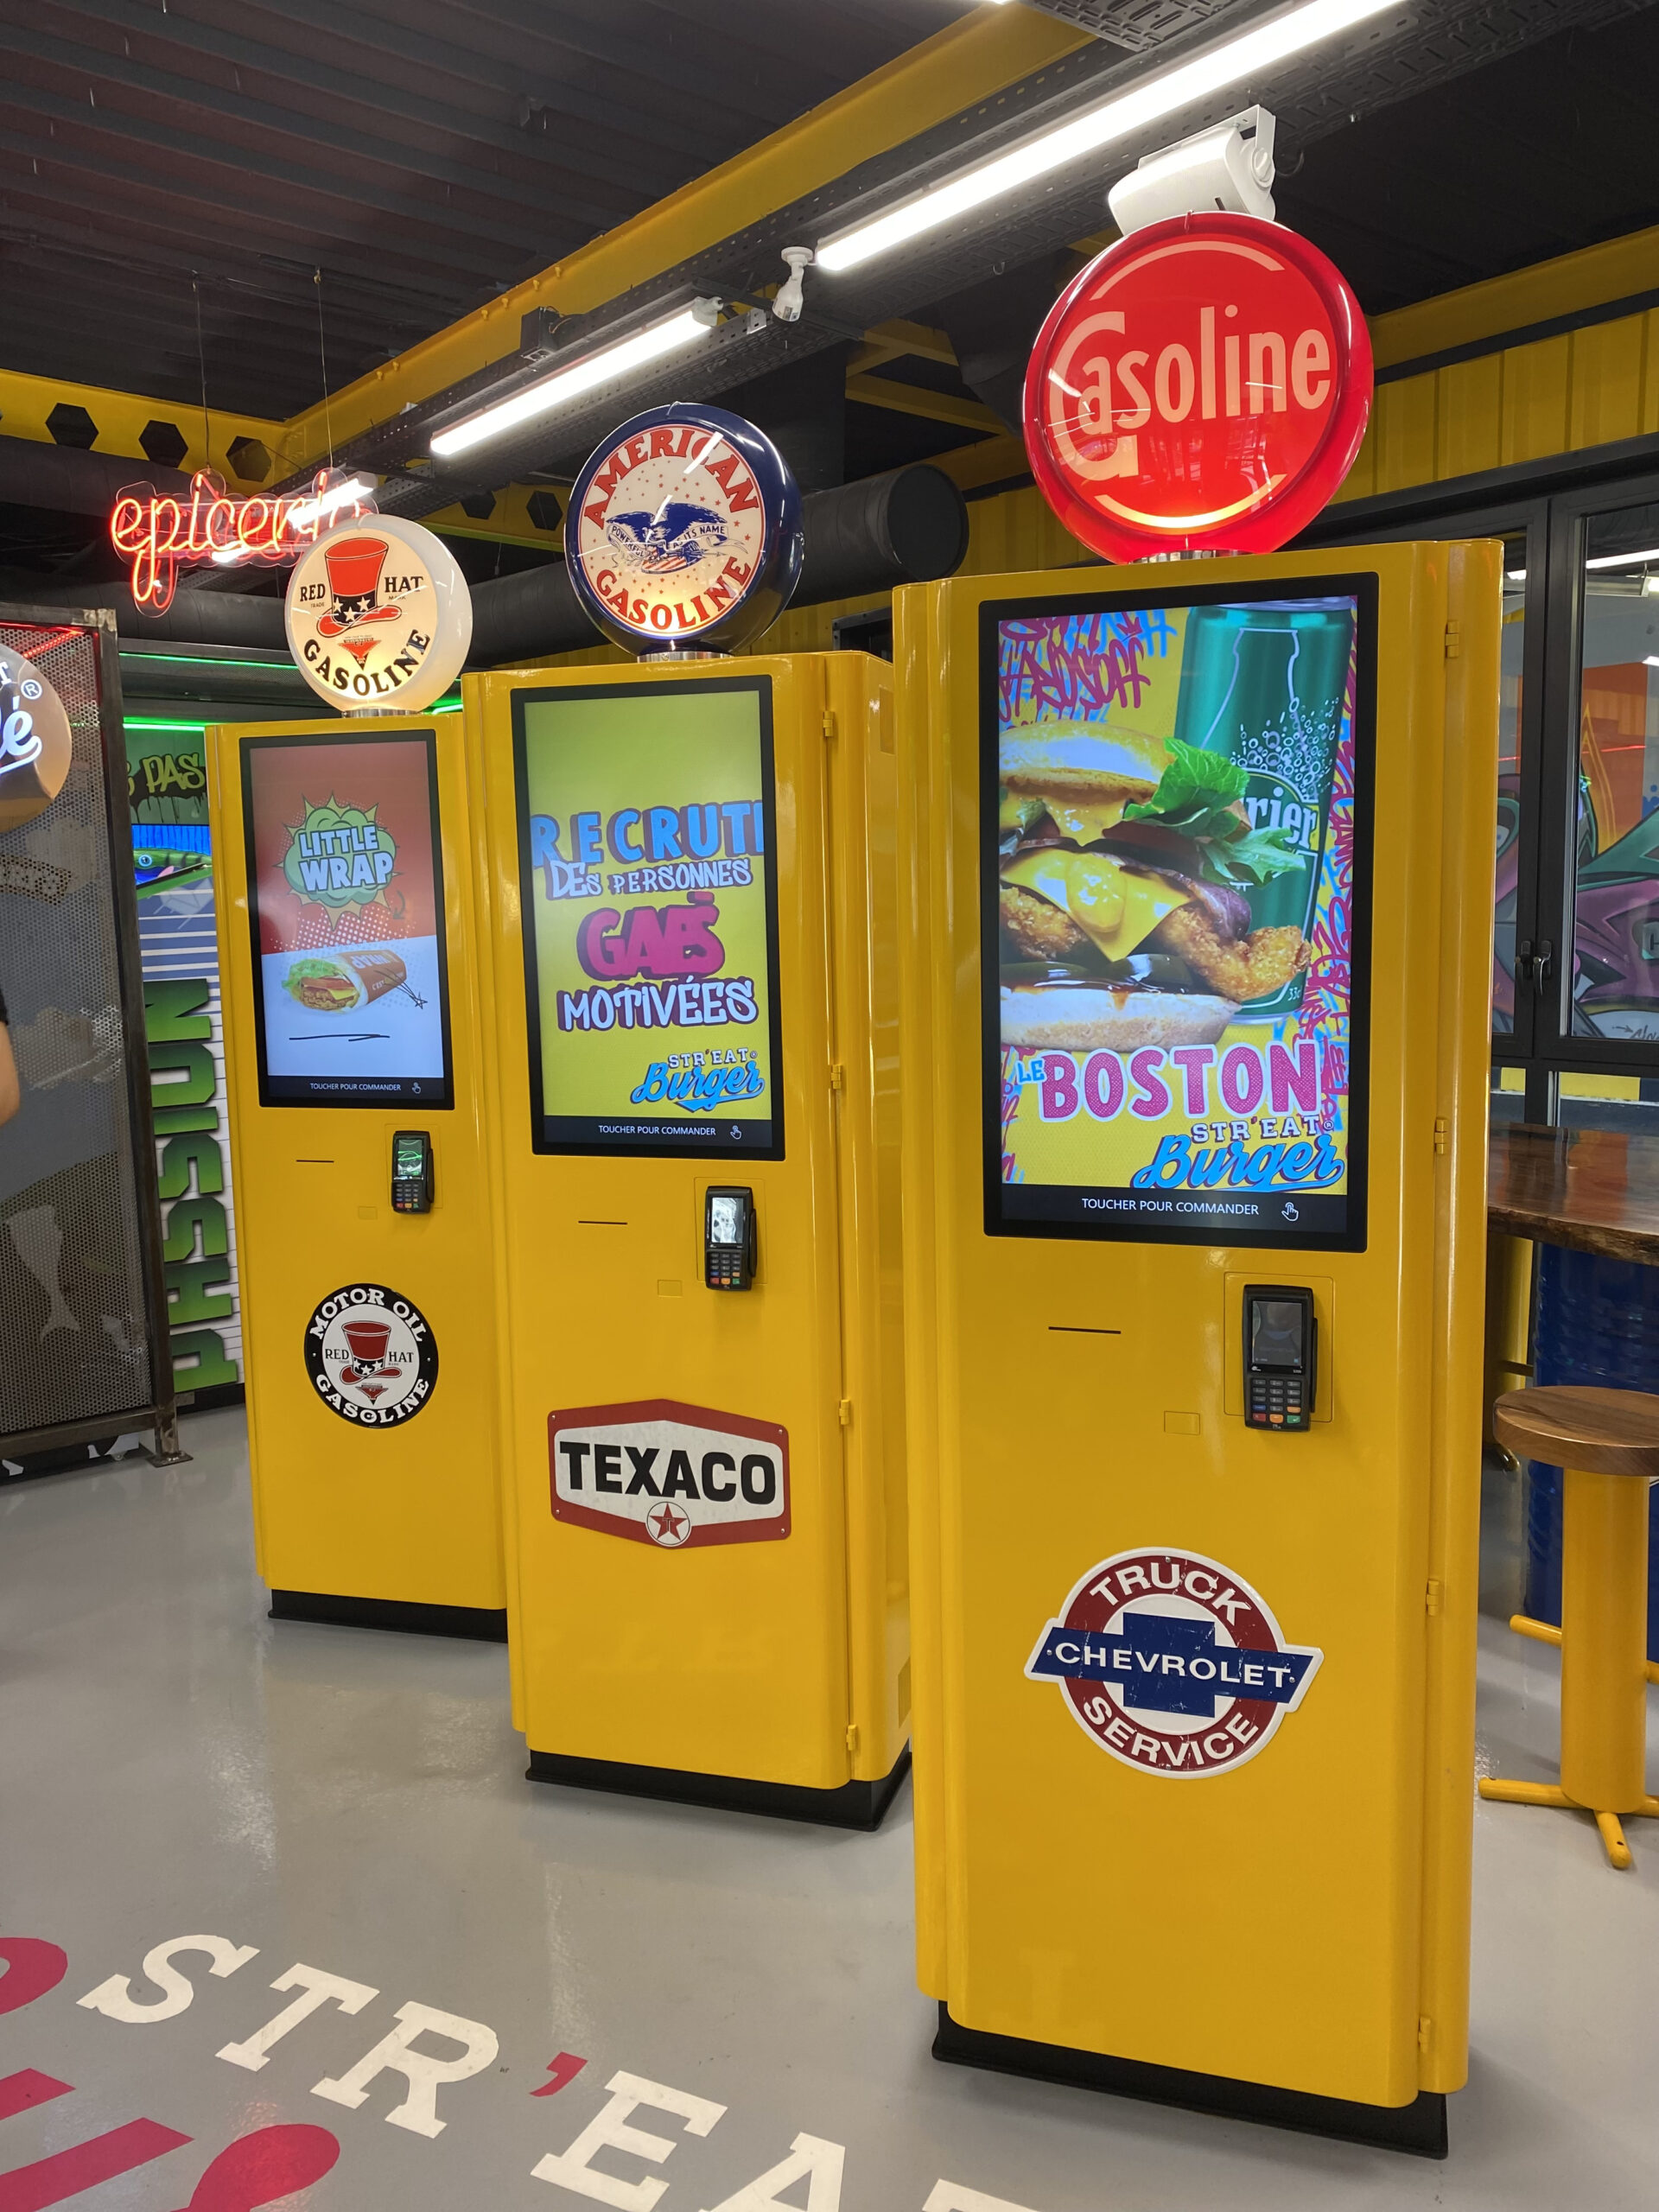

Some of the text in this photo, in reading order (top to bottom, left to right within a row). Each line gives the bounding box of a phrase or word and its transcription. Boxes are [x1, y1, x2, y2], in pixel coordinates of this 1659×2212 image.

[1049, 304, 1331, 480] Gasoline
[584, 429, 759, 530] AMERICAN
[612, 525, 725, 557] POWERFUL AS ITS NAME
[300, 576, 423, 602] RED HAT
[596, 556, 751, 630] GASOLINE
[304, 629, 430, 696] GASOLINE
[142, 753, 206, 793] PAS
[298, 824, 378, 857] LITTLE
[298, 852, 394, 893] WRAP
[550, 857, 752, 898] DES PERSONNES
[562, 975, 758, 1030] MOTIVÉES
[630, 1060, 766, 1112] Burger
[1017, 1060, 1046, 1083] LE
[1039, 1041, 1319, 1120] BOSTON
[599, 1125, 635, 1134] TOUCHER
[661, 1127, 716, 1135] COMMANDER
[1131, 1134, 1345, 1192] Burger
[1082, 1198, 1260, 1215] TOUCHER POUR COMMANDER
[309, 1287, 427, 1342] MOTOR OIL
[325, 1348, 414, 1363] RED HAT
[315, 1374, 429, 1424] GASOLINE
[560, 1440, 776, 1505] TEXACO
[1089, 1561, 1252, 1626] TRUCK
[1055, 1641, 1292, 1688] CHEVROLET
[1084, 1695, 1259, 1767] SERVICE
[76, 1934, 1040, 2212] STR'EA
